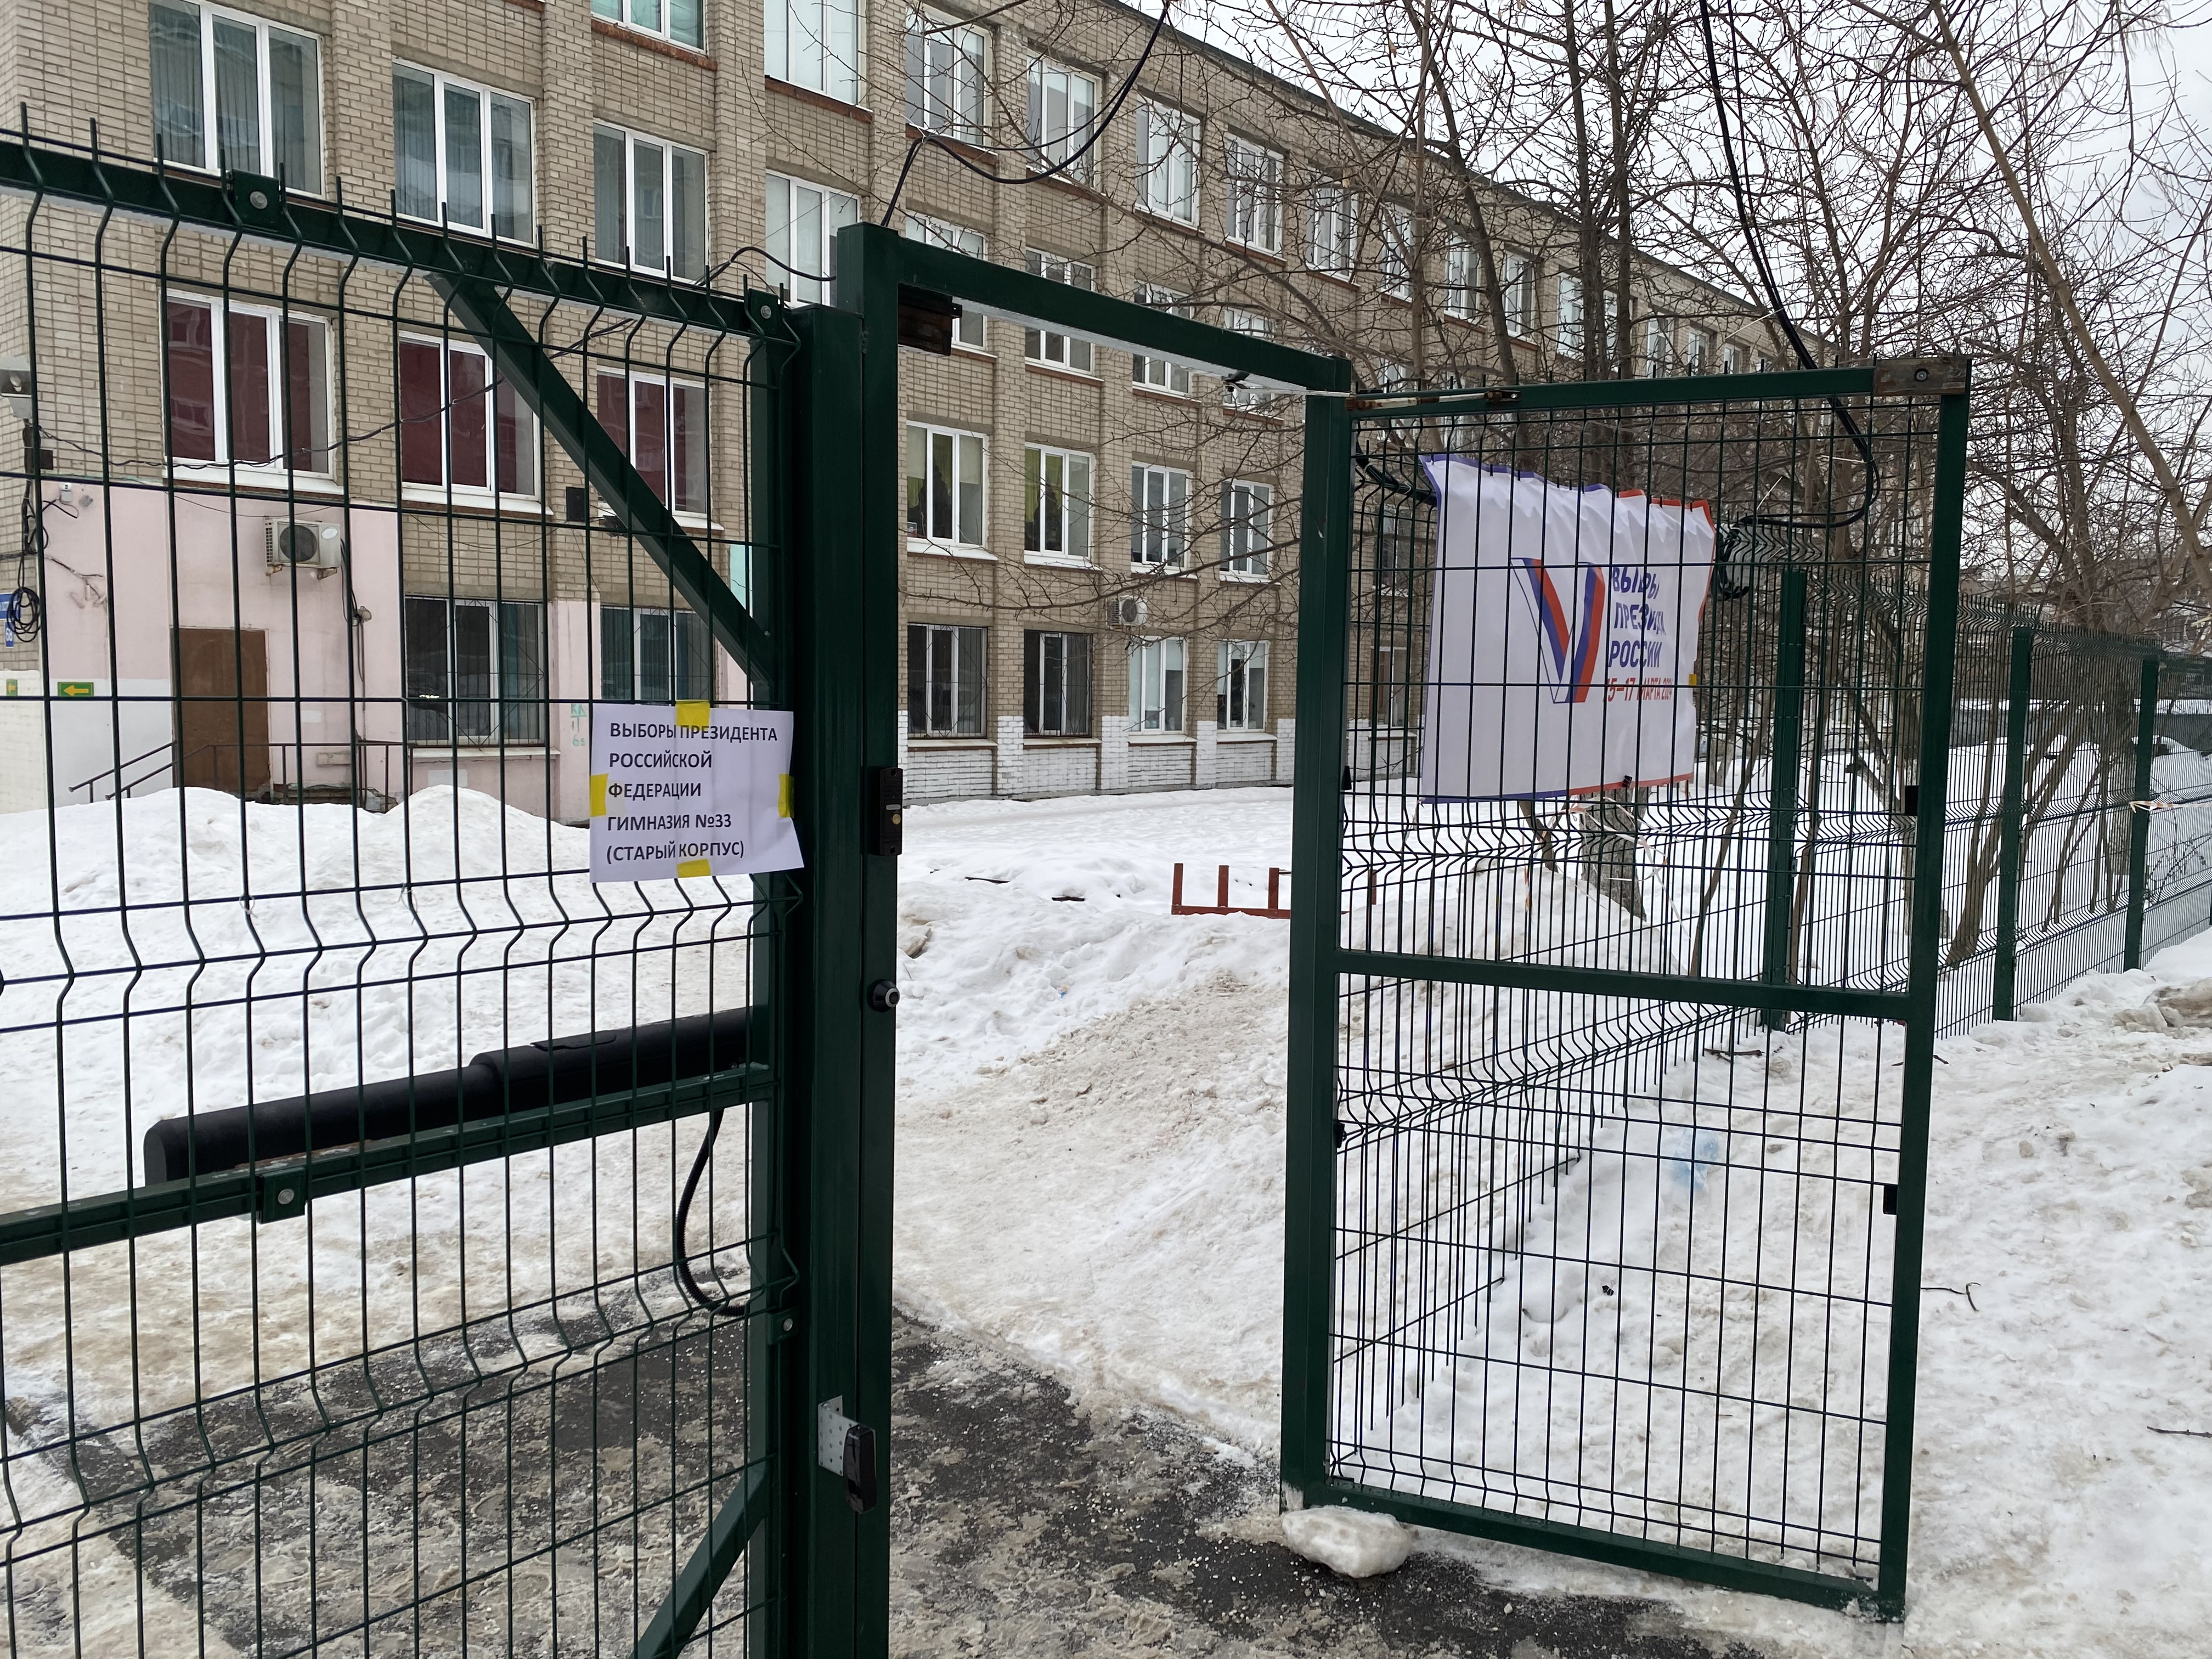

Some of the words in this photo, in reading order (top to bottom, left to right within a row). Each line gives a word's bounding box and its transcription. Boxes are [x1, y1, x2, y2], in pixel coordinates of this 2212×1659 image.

[610, 723, 676, 738] ВЫБОРЫ
[680, 725, 778, 743] ПРЕЗИДЕНТА
[609, 749, 712, 768] РОССИЙСКОЙ
[608, 782, 702, 801] ФЕДЕРАЦИИ
[607, 814, 690, 831] ГИМНАЗИЯ
[695, 814, 732, 828] №33
[606, 840, 676, 864] (СТАРЫЙ
[679, 840, 744, 858] КОРПУС)
